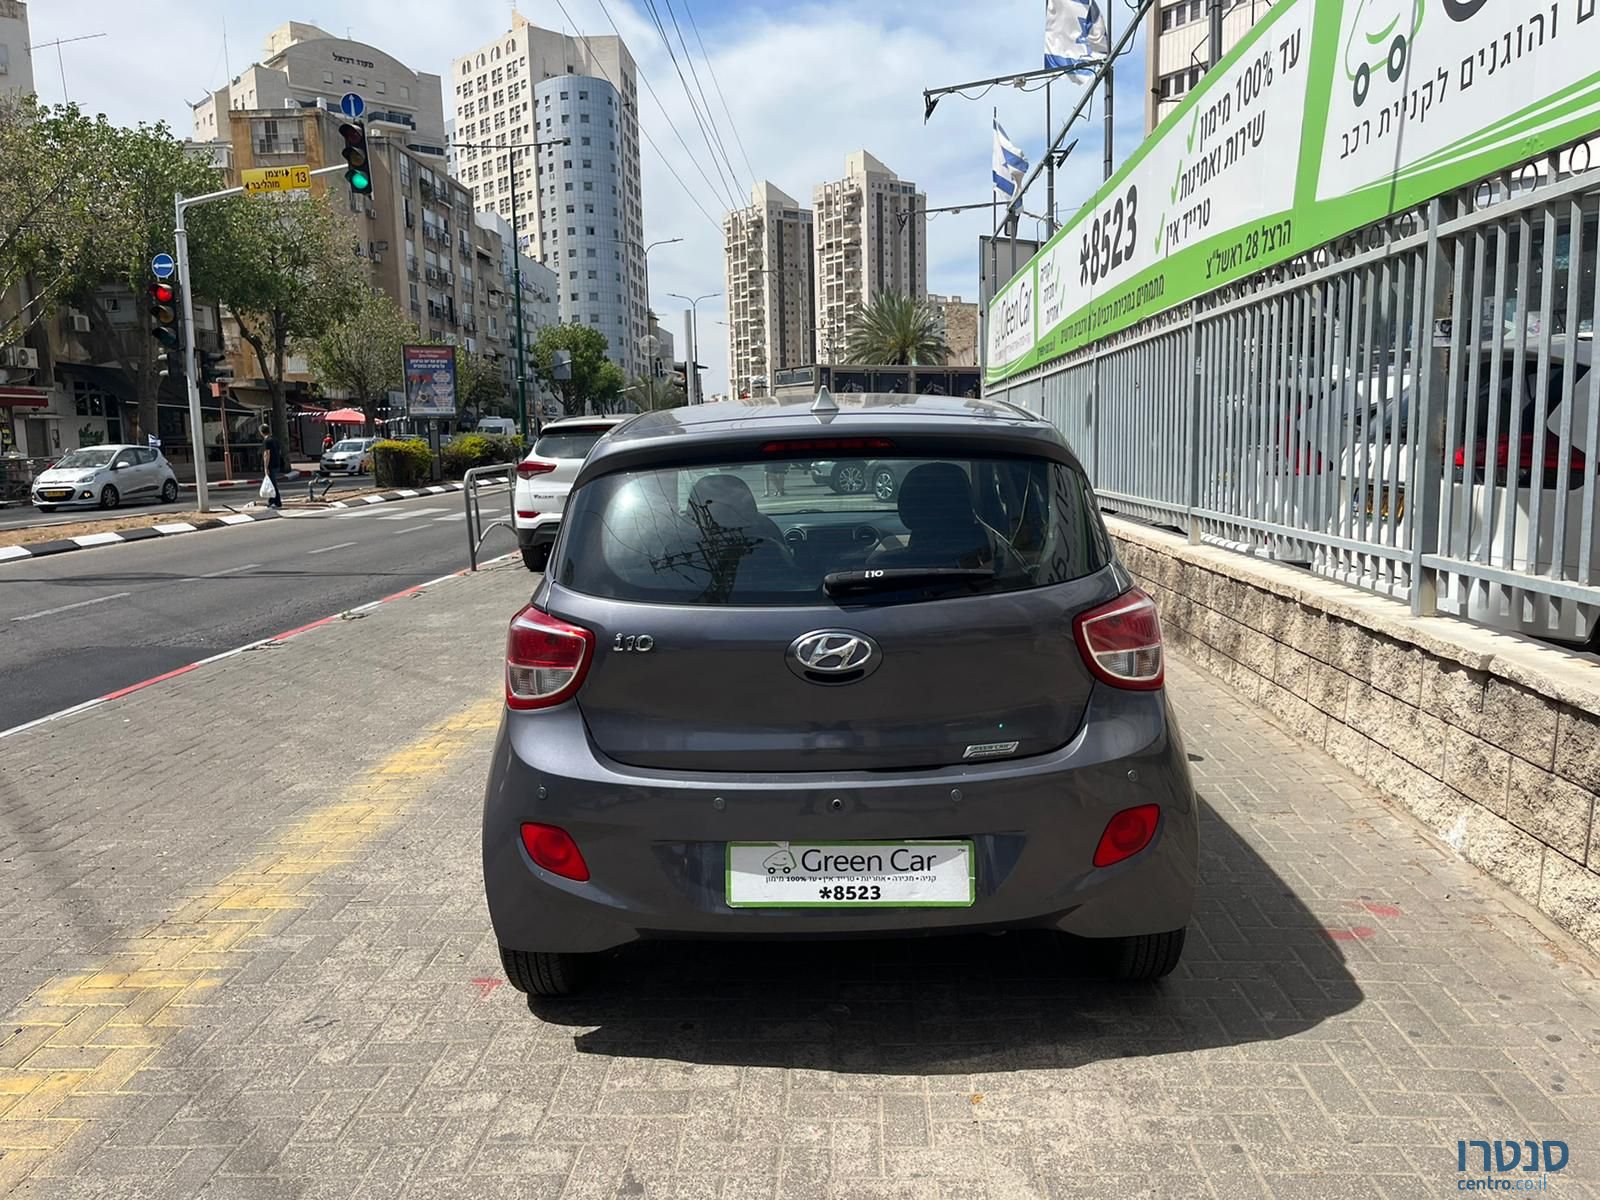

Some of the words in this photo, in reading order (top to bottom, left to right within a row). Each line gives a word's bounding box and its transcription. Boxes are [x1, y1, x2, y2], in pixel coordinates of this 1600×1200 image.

[1280, 28, 1301, 74] עד
[1460, 2, 1558, 91] והוגנים
[1236, 51, 1273, 112] 100%
[1378, 66, 1449, 138] לקניית
[1200, 92, 1230, 153] מימון
[1224, 110, 1266, 170] שירות
[1340, 119, 1370, 159] רכב
[295, 172, 307, 183] 13
[1180, 145, 1221, 202] ואמינות
[1166, 218, 1180, 258] אין
[1183, 197, 1211, 239] טרייד
[1262, 219, 1291, 254] הרצל
[1245, 230, 1259, 262] 28
[1137, 274, 1164, 308] מתמחים
[864, 570, 884, 578] i10
[613, 632, 654, 652] i10
[801, 849, 882, 872] Green
[890, 849, 937, 872] Car
[920, 875, 937, 883] קניה
